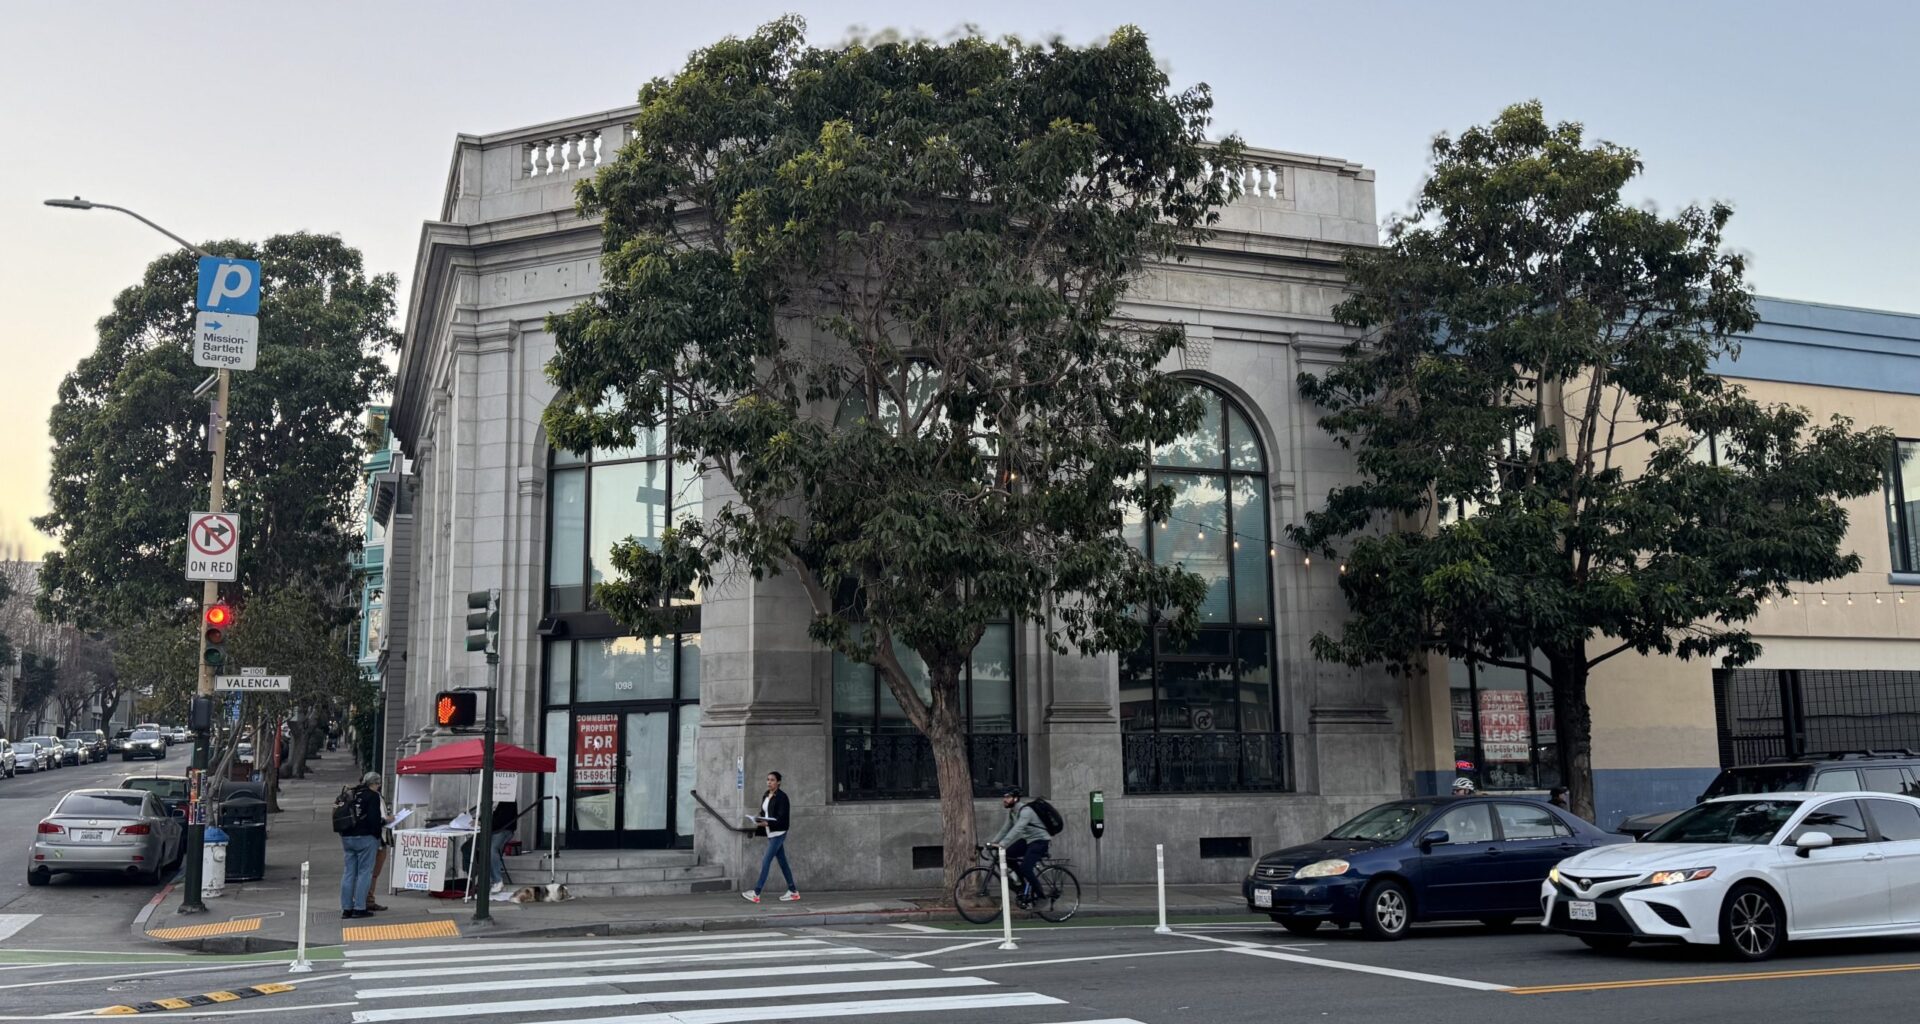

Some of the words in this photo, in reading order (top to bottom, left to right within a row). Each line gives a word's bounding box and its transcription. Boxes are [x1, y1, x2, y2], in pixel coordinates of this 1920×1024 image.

[203, 332, 248, 345] Mission-
[203, 342, 244, 354] Bartlett
[202, 352, 241, 364] Garage
[190, 560, 206, 572] ON
[210, 561, 233, 573] RED
[250, 667, 264, 675] 1100
[226, 678, 280, 688] VALENCIA
[615, 681, 633, 690] 1098
[1491, 713, 1518, 726] FOR
[584, 735, 613, 749] FOR
[1485, 729, 1527, 742] LEASE
[575, 753, 618, 767] LEASE
[401, 834, 422, 847] SIGN
[424, 835, 448, 849] HERE
[402, 846, 440, 859] Everyone
[405, 857, 437, 870] Matters
[408, 873, 429, 884] VOTE
